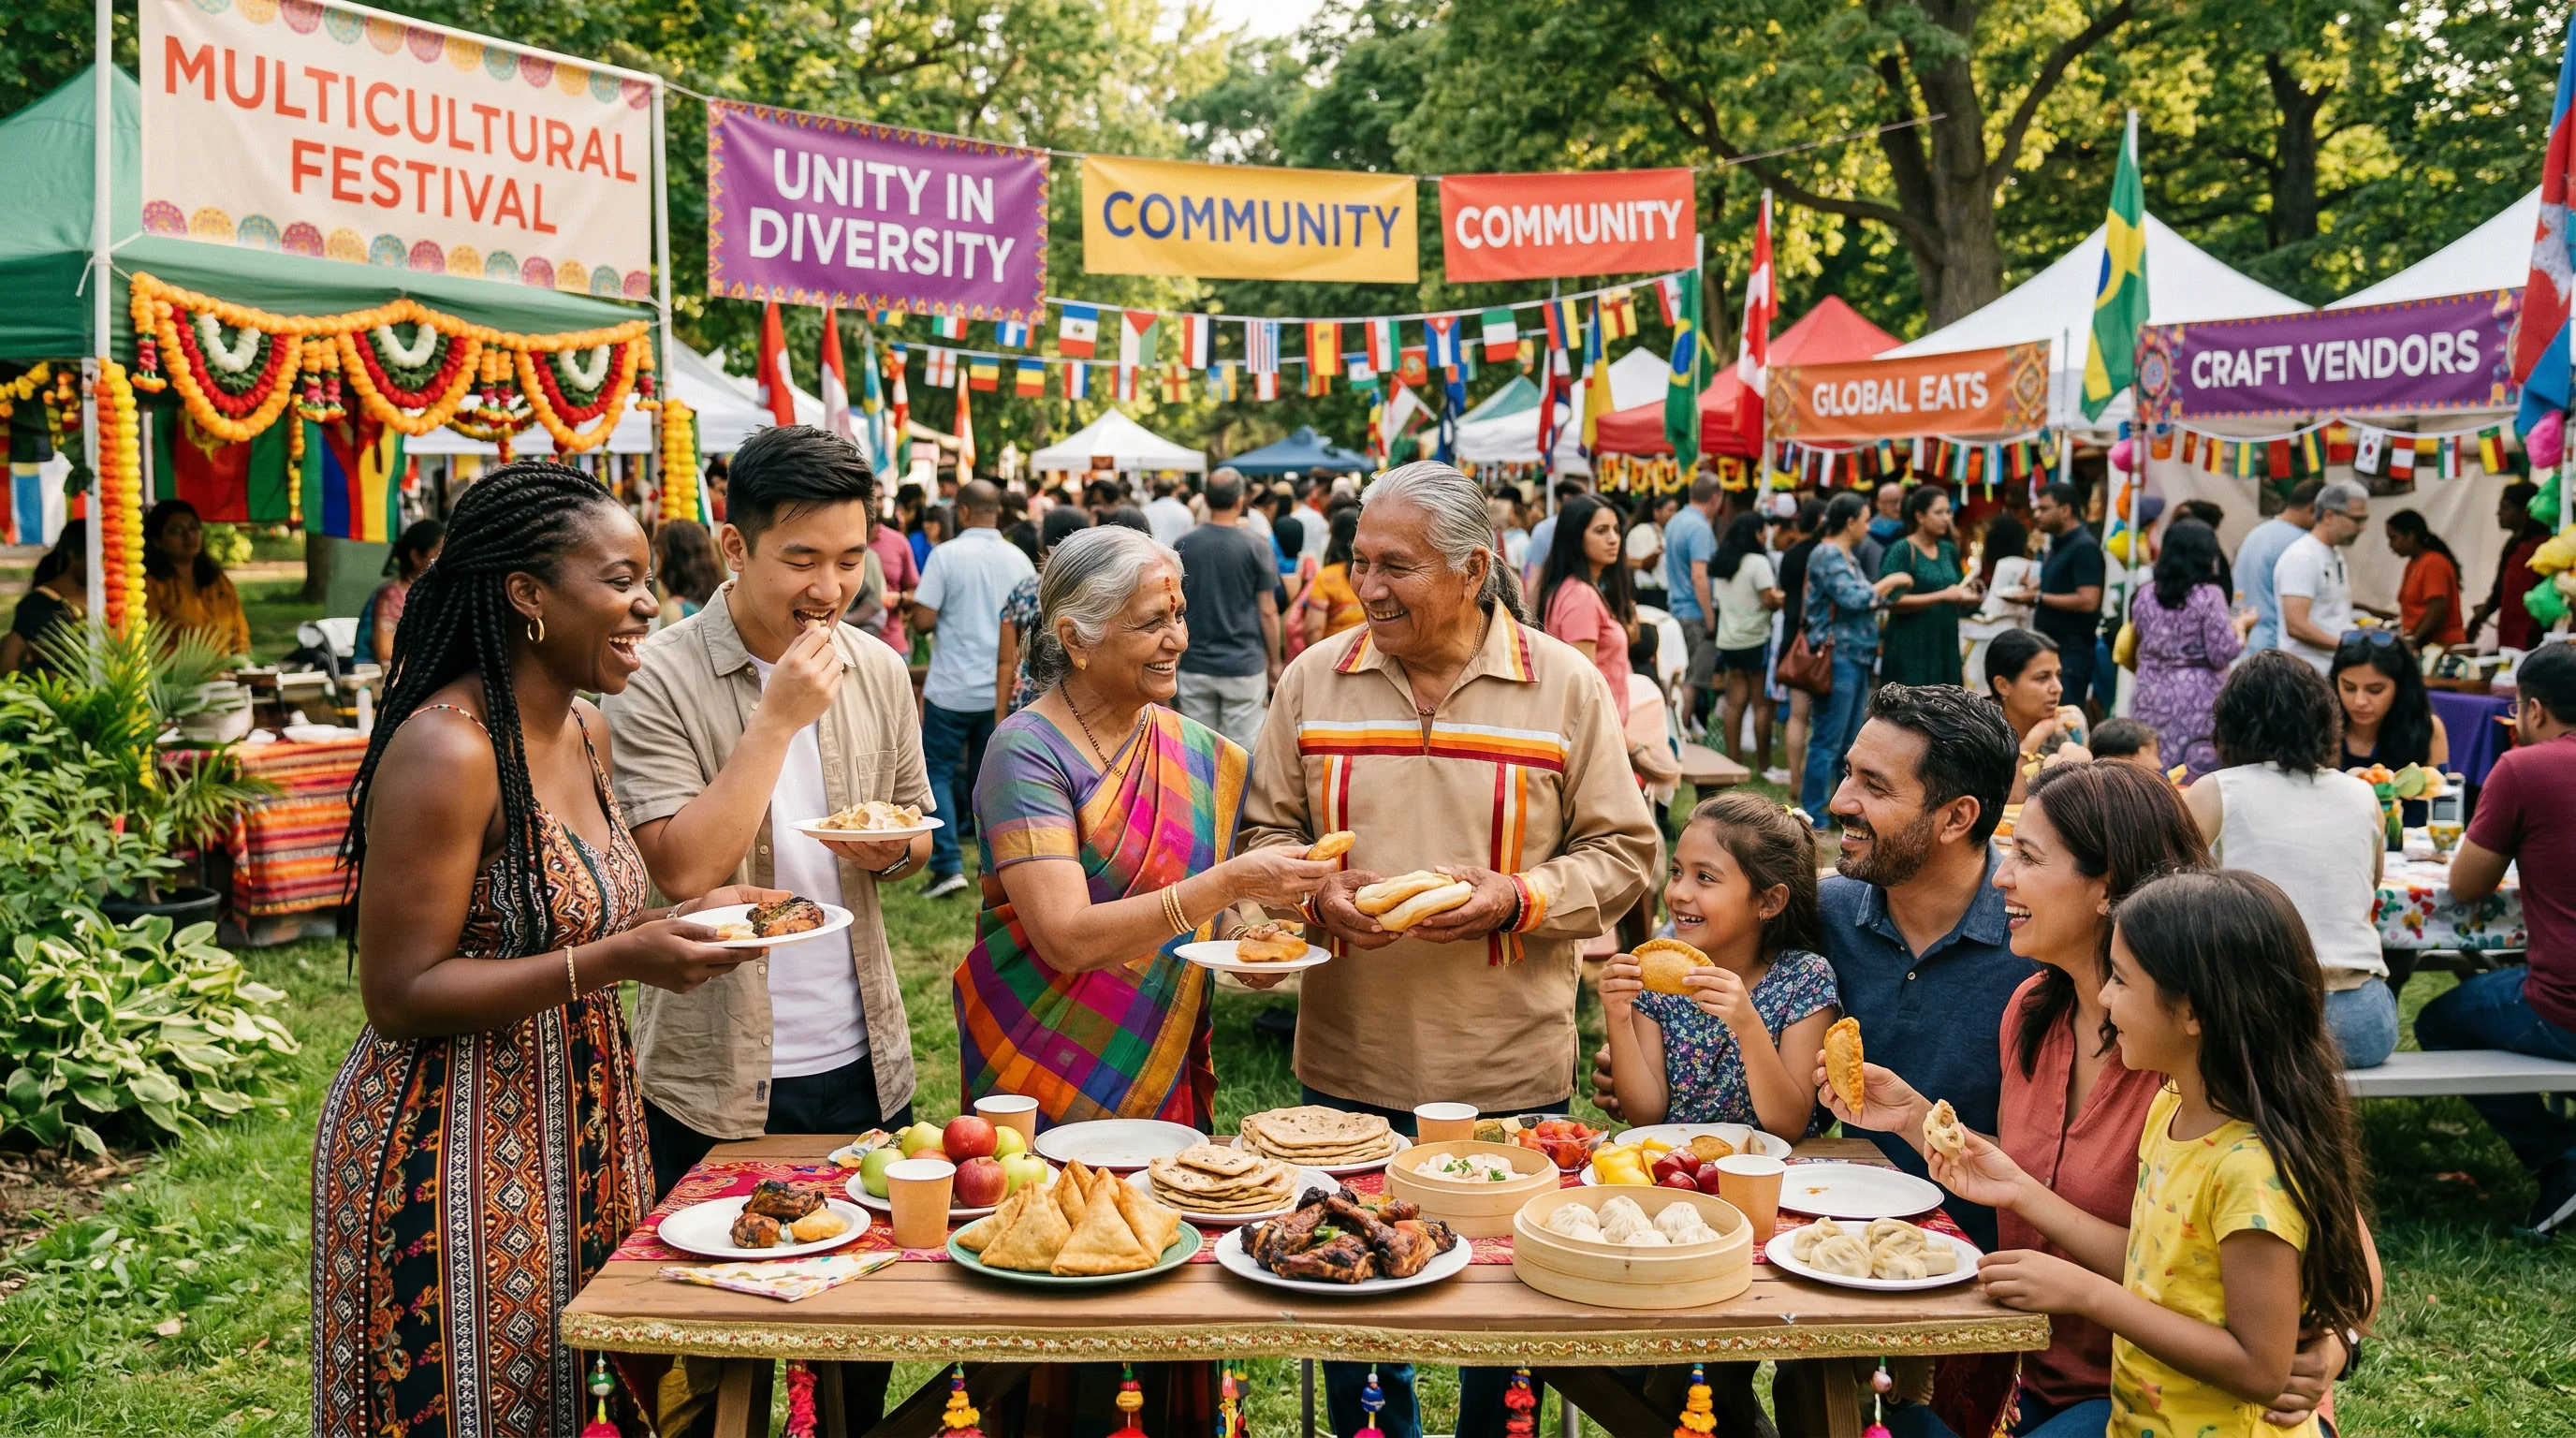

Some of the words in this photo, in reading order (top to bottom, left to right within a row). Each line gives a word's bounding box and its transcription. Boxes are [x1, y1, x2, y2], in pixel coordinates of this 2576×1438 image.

[165, 35, 637, 183] MULTICULTURAL
[291, 139, 557, 235] FESTIVAL
[773, 148, 932, 215] UNITY
[946, 173, 995, 225] IN
[1104, 191, 1401, 249] COMMUNITY
[750, 207, 1016, 283] DIVERSITY
[1456, 199, 1683, 250] COMMUNITY
[2190, 345, 2292, 390] CRAFT
[2301, 329, 2481, 384] VENDORS
[1812, 380, 1911, 418] GLOBAL
[1919, 372, 1989, 411] EATS
